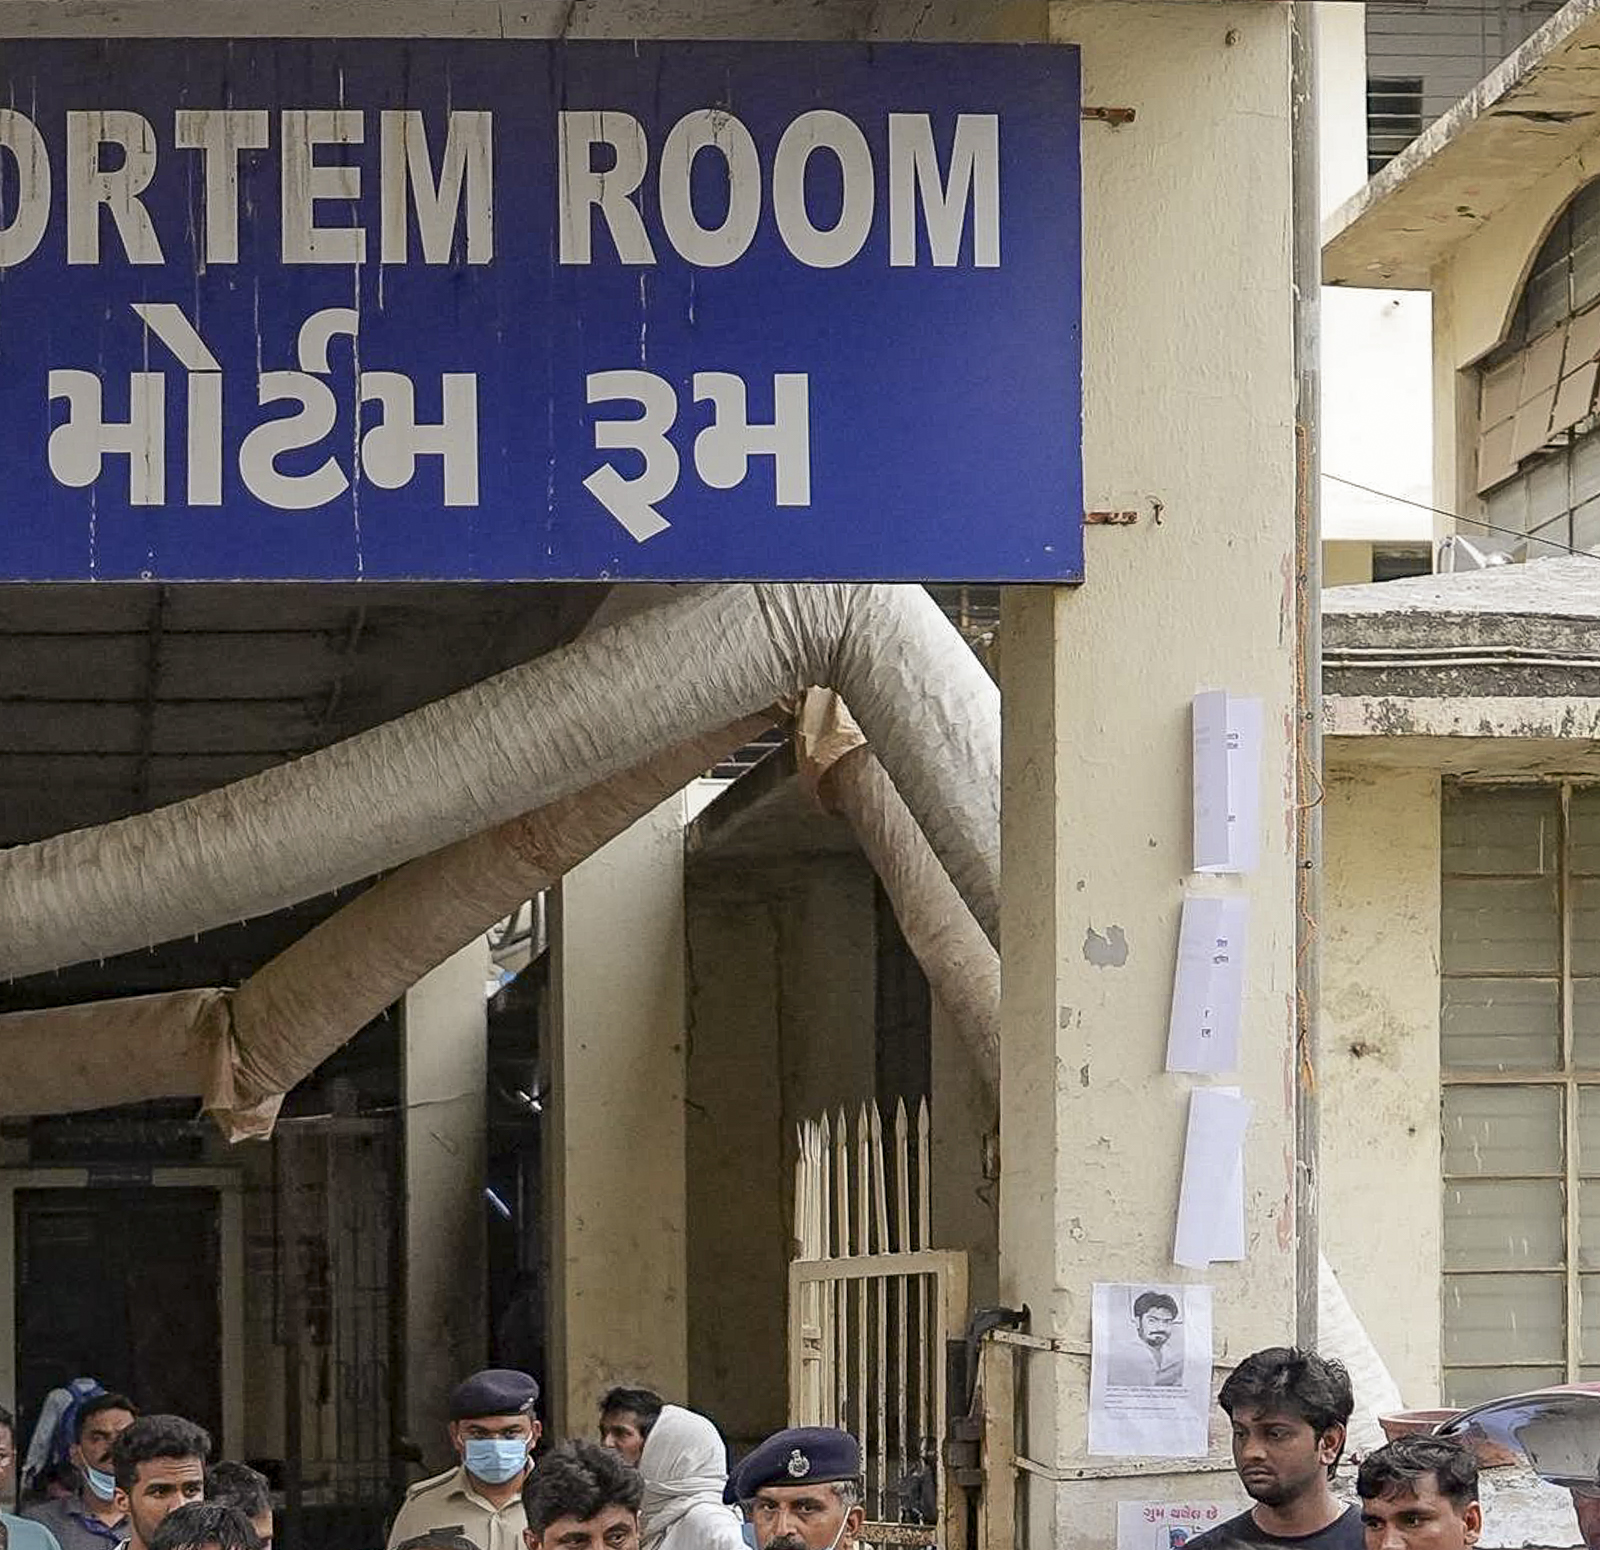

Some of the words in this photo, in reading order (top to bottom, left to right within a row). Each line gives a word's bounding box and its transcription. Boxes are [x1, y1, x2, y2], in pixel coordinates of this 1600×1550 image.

[557, 108, 1001, 269] ROOM
[47, 302, 480, 511] મોર્ટમ
[581, 370, 811, 544] રૂમ
